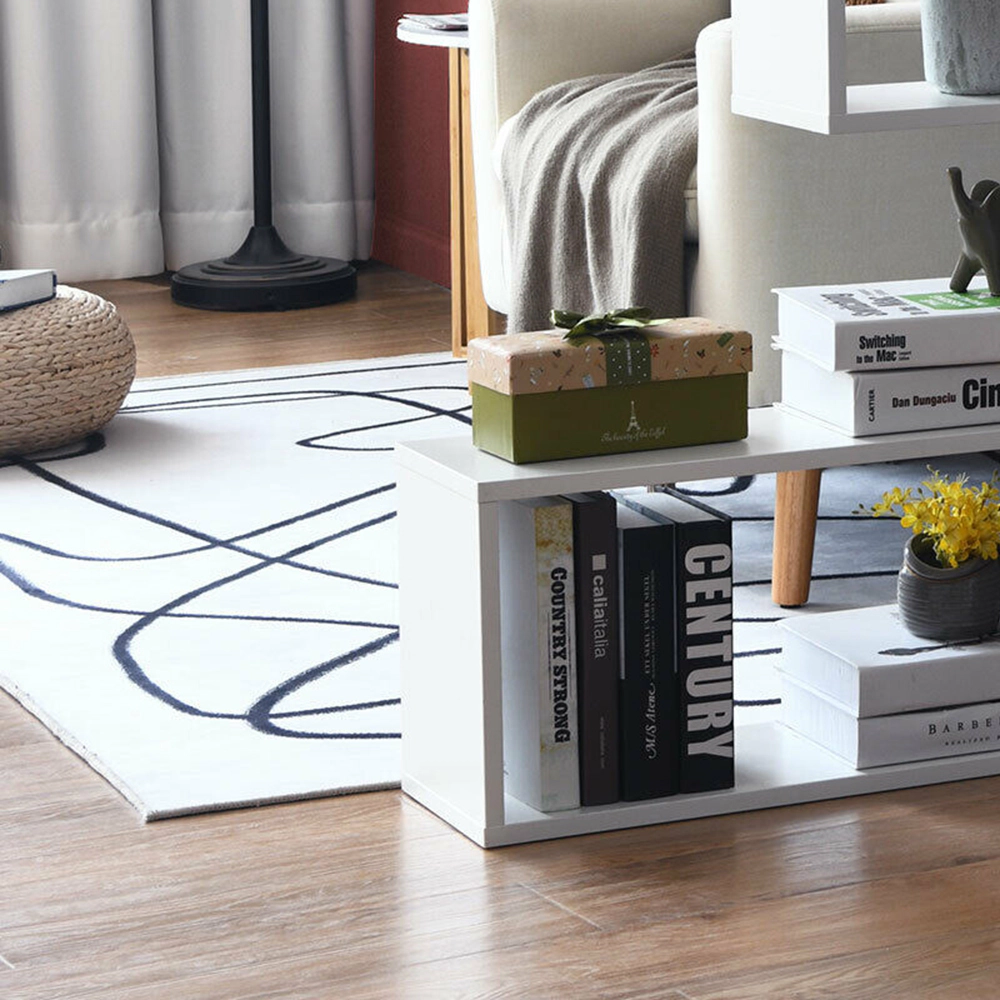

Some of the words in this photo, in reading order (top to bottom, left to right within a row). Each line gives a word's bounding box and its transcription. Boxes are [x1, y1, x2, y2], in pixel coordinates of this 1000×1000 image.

[856, 355, 863, 364] to
[864, 354, 874, 363] the
[876, 349, 897, 362] Mac
[859, 333, 906, 350] Switching
[867, 389, 876, 422] CARTIER
[892, 397, 910, 408] Dan
[912, 392, 957, 407] Dungaciu
[550, 566, 568, 661] COUNTRY
[592, 574, 608, 659] caliaitalia
[684, 542, 734, 758] CENTURY
[552, 663, 571, 744] STRONG
